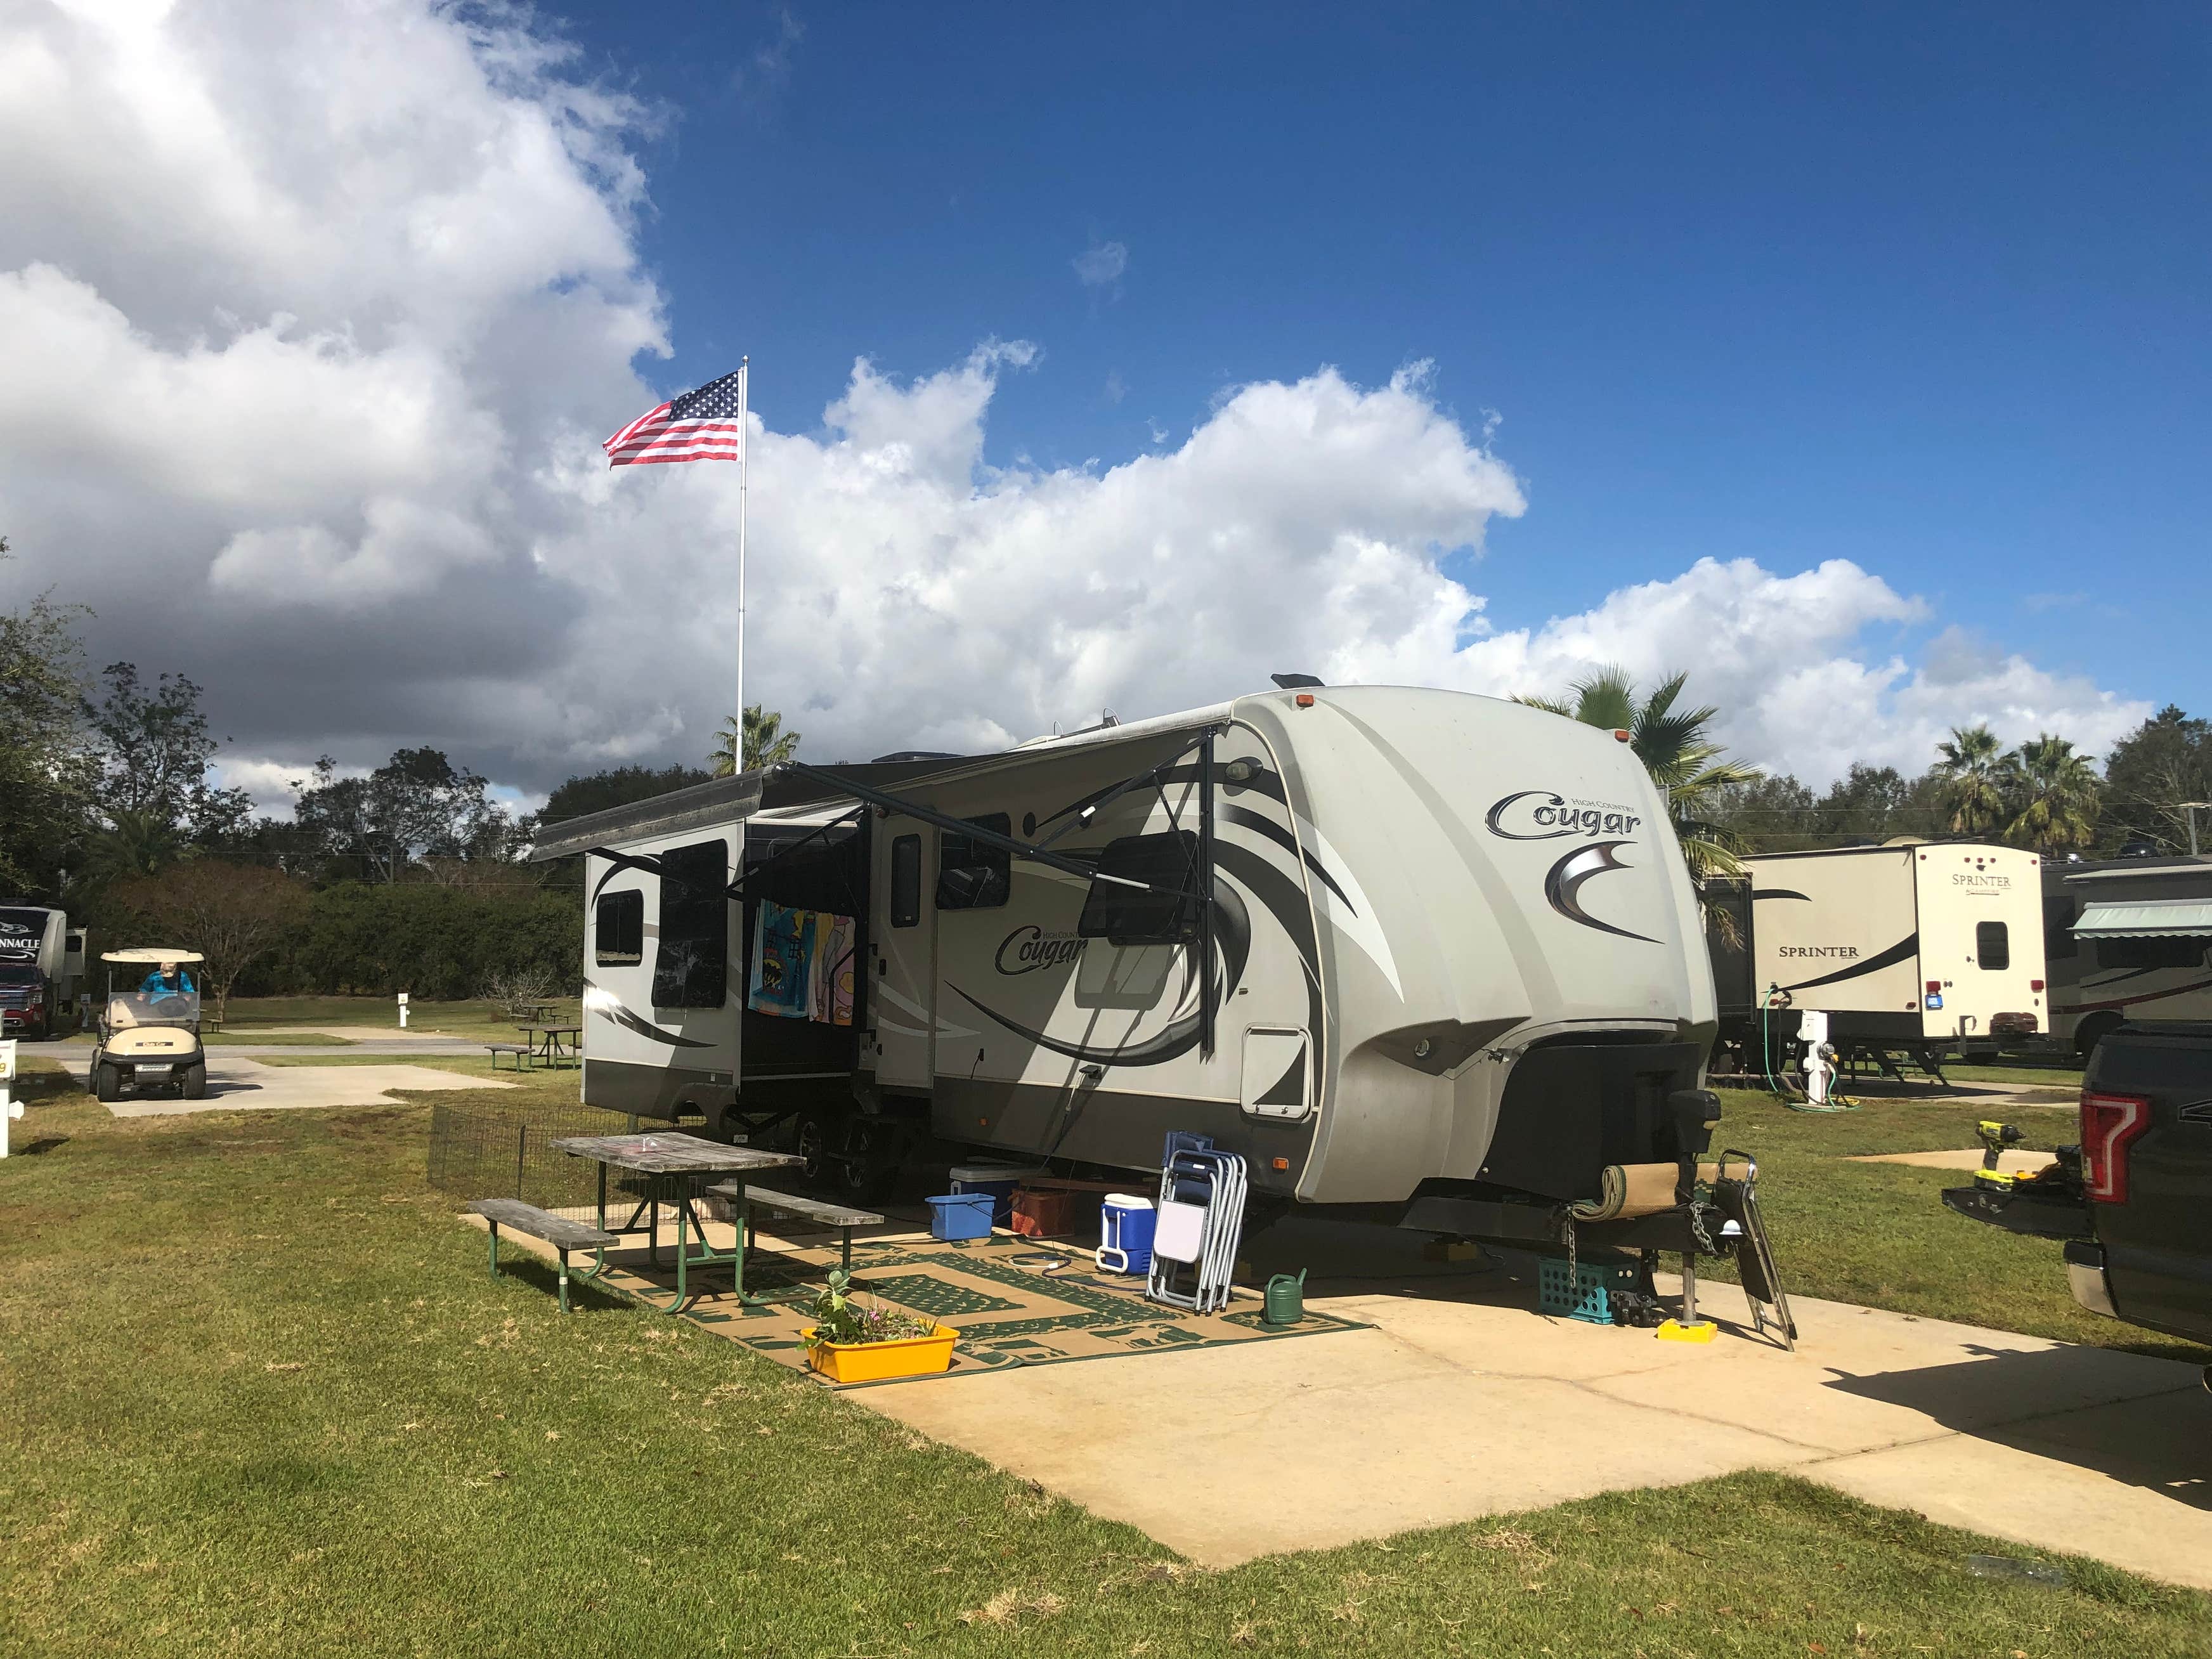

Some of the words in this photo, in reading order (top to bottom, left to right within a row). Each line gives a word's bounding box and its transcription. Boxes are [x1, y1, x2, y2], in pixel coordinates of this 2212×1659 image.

[1571, 798, 1596, 807] HIGH
[1596, 801, 1635, 813] COUNTRY
[1485, 790, 1641, 840] Cougar
[1952, 874, 2012, 887] SPRINTER
[1058, 931, 1079, 939] COUNT
[0, 938, 41, 949] NNACLE
[994, 925, 1088, 975] Cougar
[1779, 946, 1859, 957] SPRINTER
